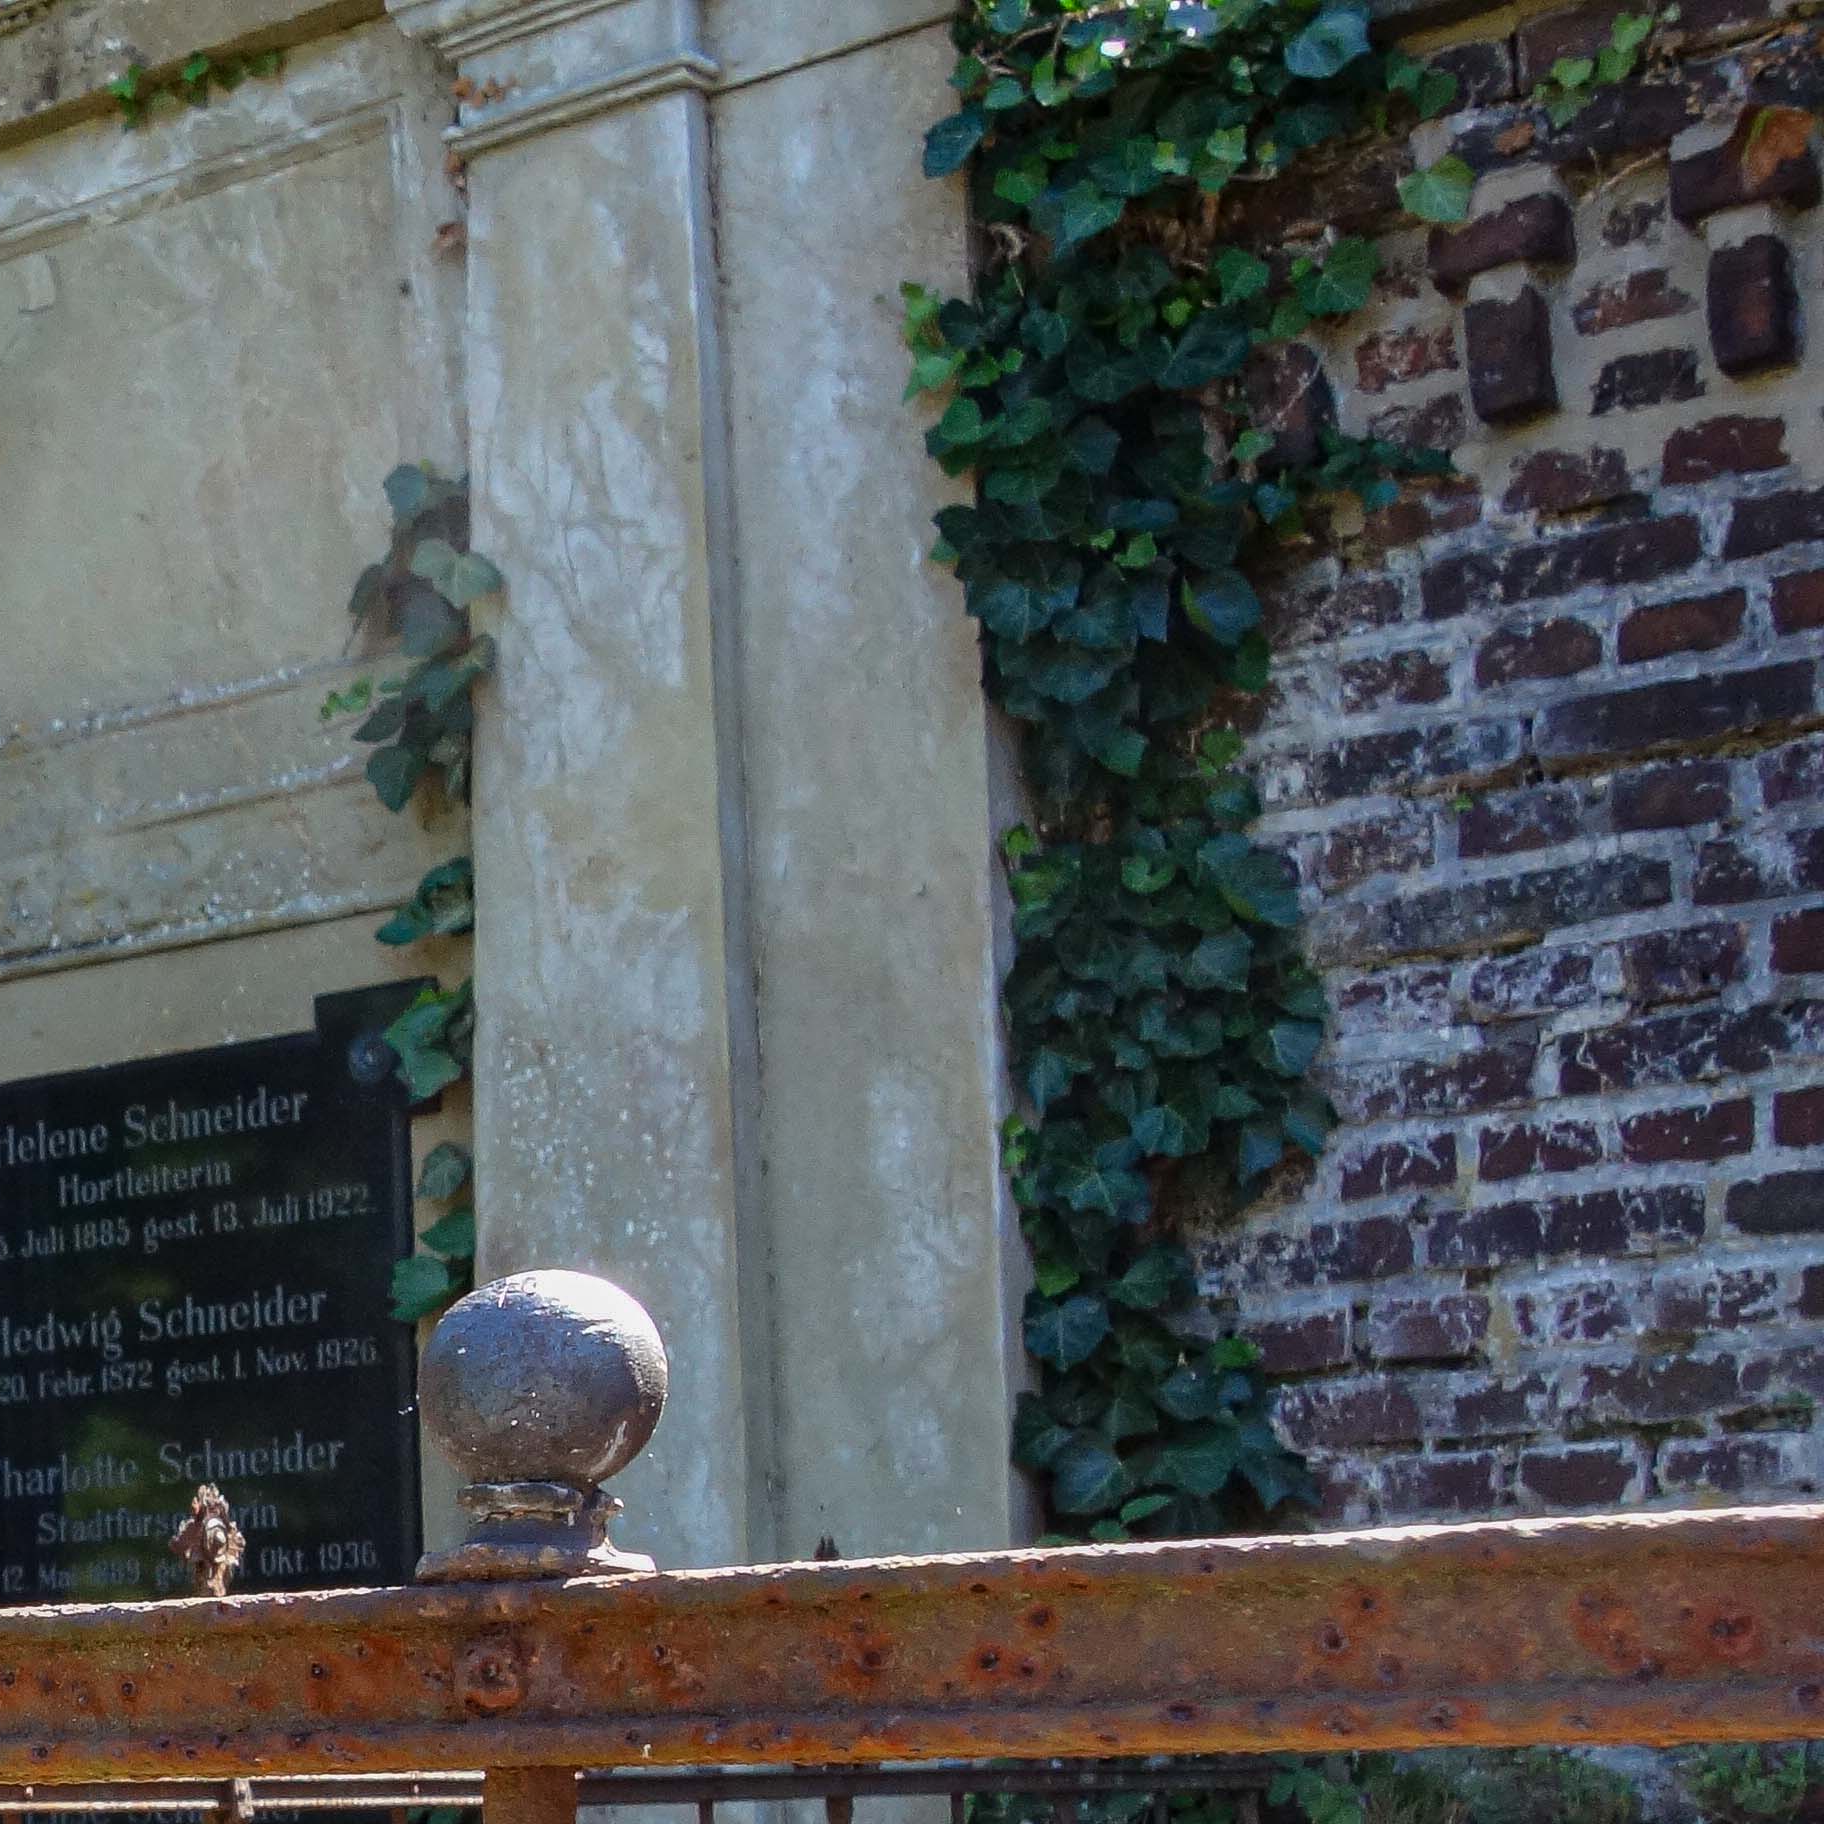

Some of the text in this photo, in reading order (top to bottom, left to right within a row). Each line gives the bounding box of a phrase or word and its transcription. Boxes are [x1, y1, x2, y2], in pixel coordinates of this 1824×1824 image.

[123, 1084, 309, 1147] Schneider
[57, 1160, 232, 1208] Hortleiterin
[19, 1226, 65, 1258] Juli
[143, 1209, 204, 1254] gest.
[212, 1200, 245, 1233] 13.
[252, 1191, 300, 1226] Juli
[138, 1284, 328, 1342] Schneider
[38, 1368, 96, 1399] Febr.
[102, 1358, 153, 1393] 1872
[165, 1353, 226, 1397] gest.
[255, 1345, 309, 1377] Nov.
[158, 1428, 345, 1485] Schneider
